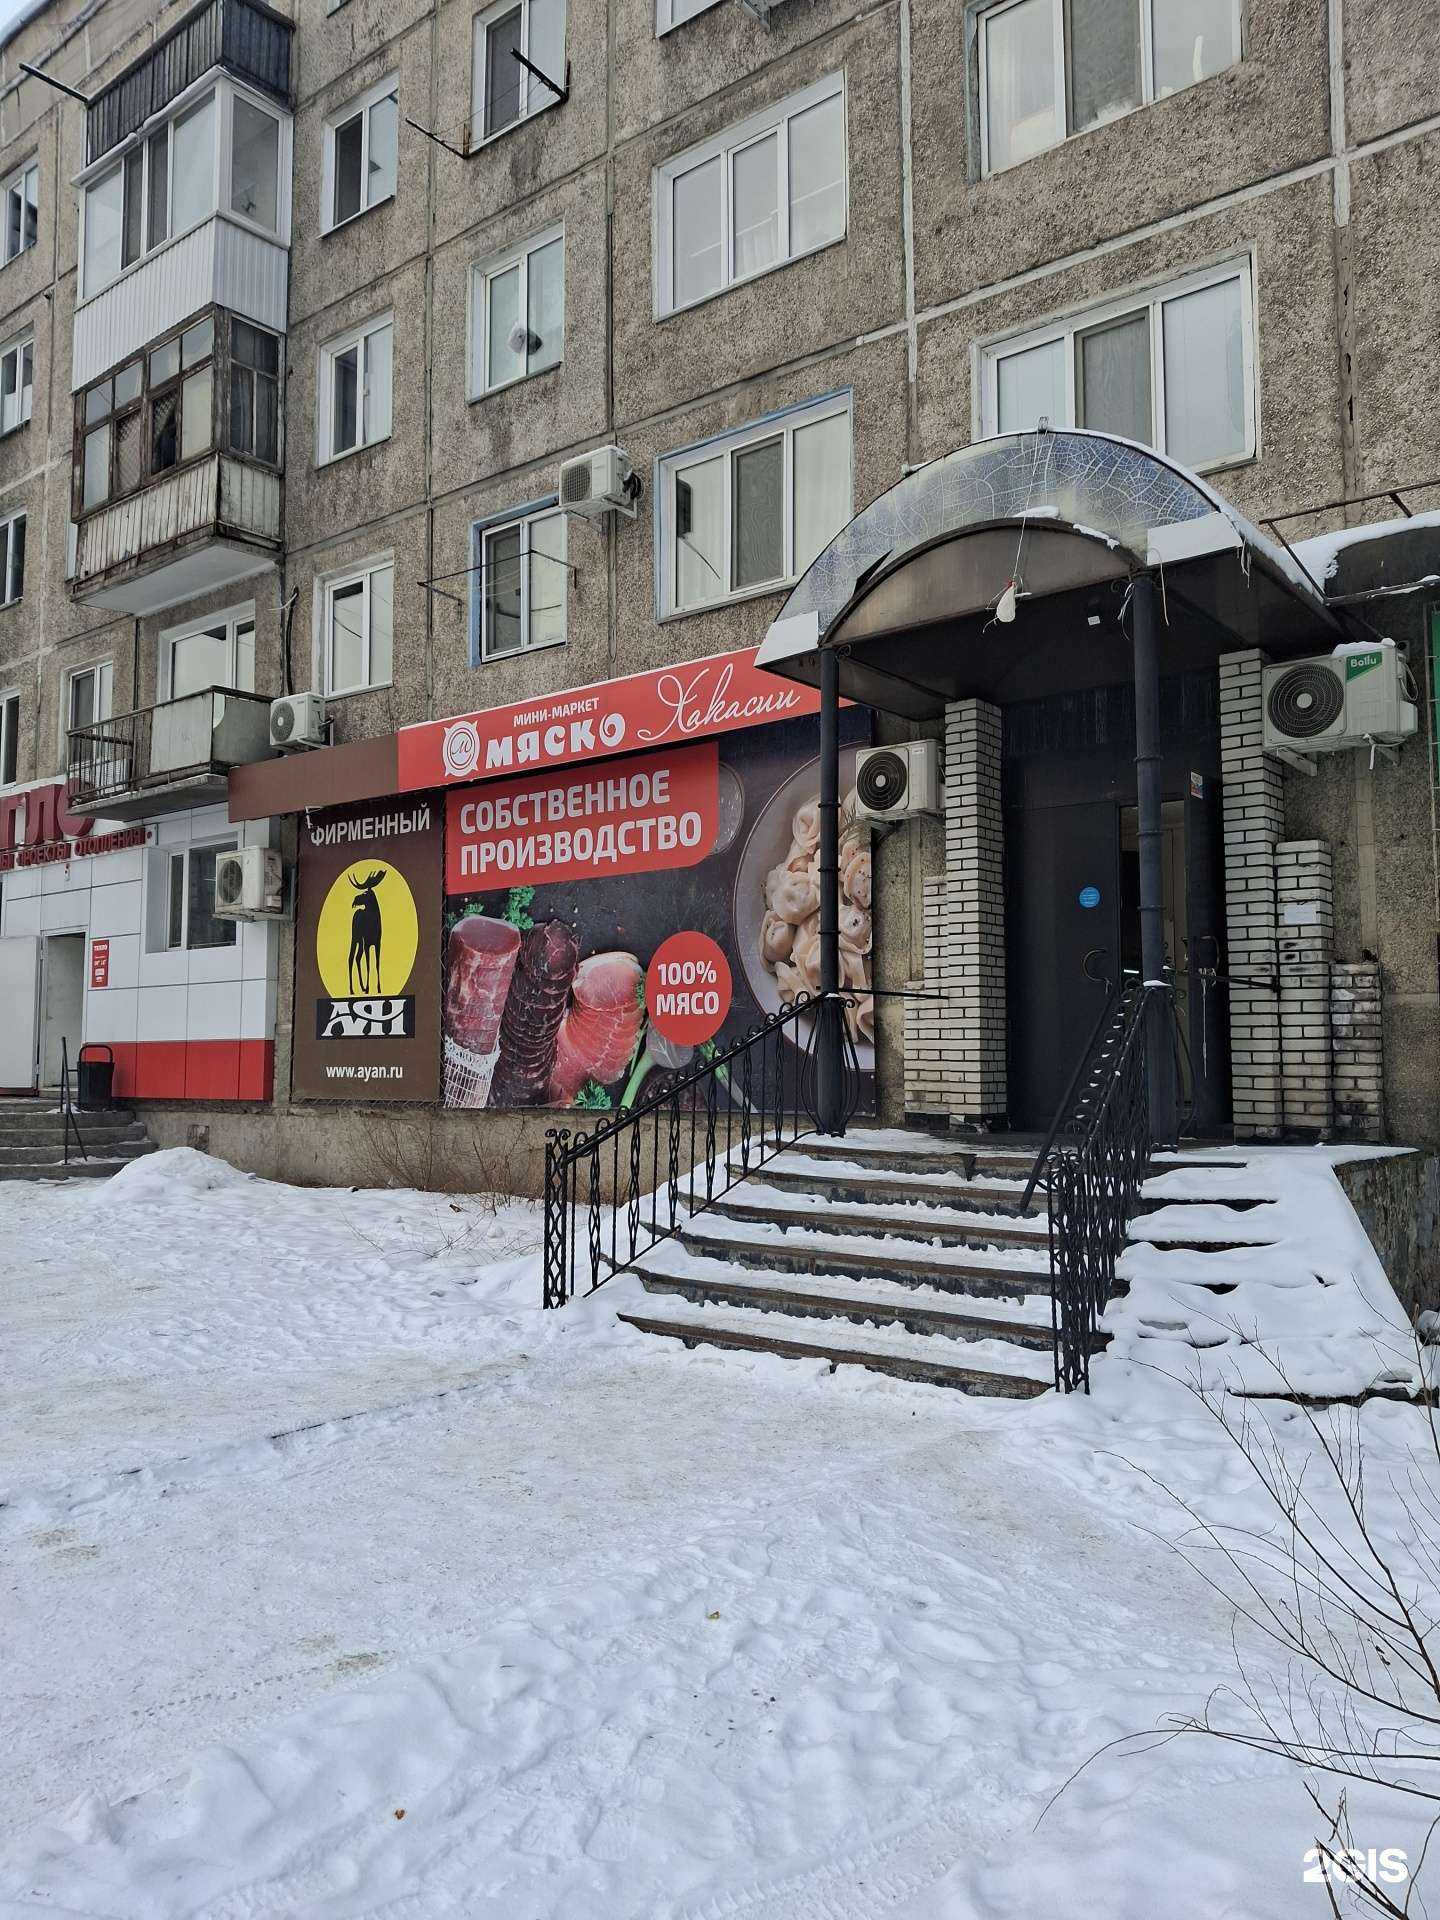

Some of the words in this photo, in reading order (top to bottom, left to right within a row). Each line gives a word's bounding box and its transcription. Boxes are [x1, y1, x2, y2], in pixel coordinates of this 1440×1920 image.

[513, 697, 600, 728] МИНИ-МАРКЕТ
[637, 663, 801, 741] Хакасии
[460, 769, 670, 834] СОБСТВЕННОЕ
[310, 802, 430, 846] ФИРМЕННЫЙ
[460, 811, 702, 875] ПРОИЗВОДСТВО
[657, 961, 717, 986] 100%
[656, 991, 720, 1016] МЯСО
[326, 1065, 403, 1082] www.ayan.ru
